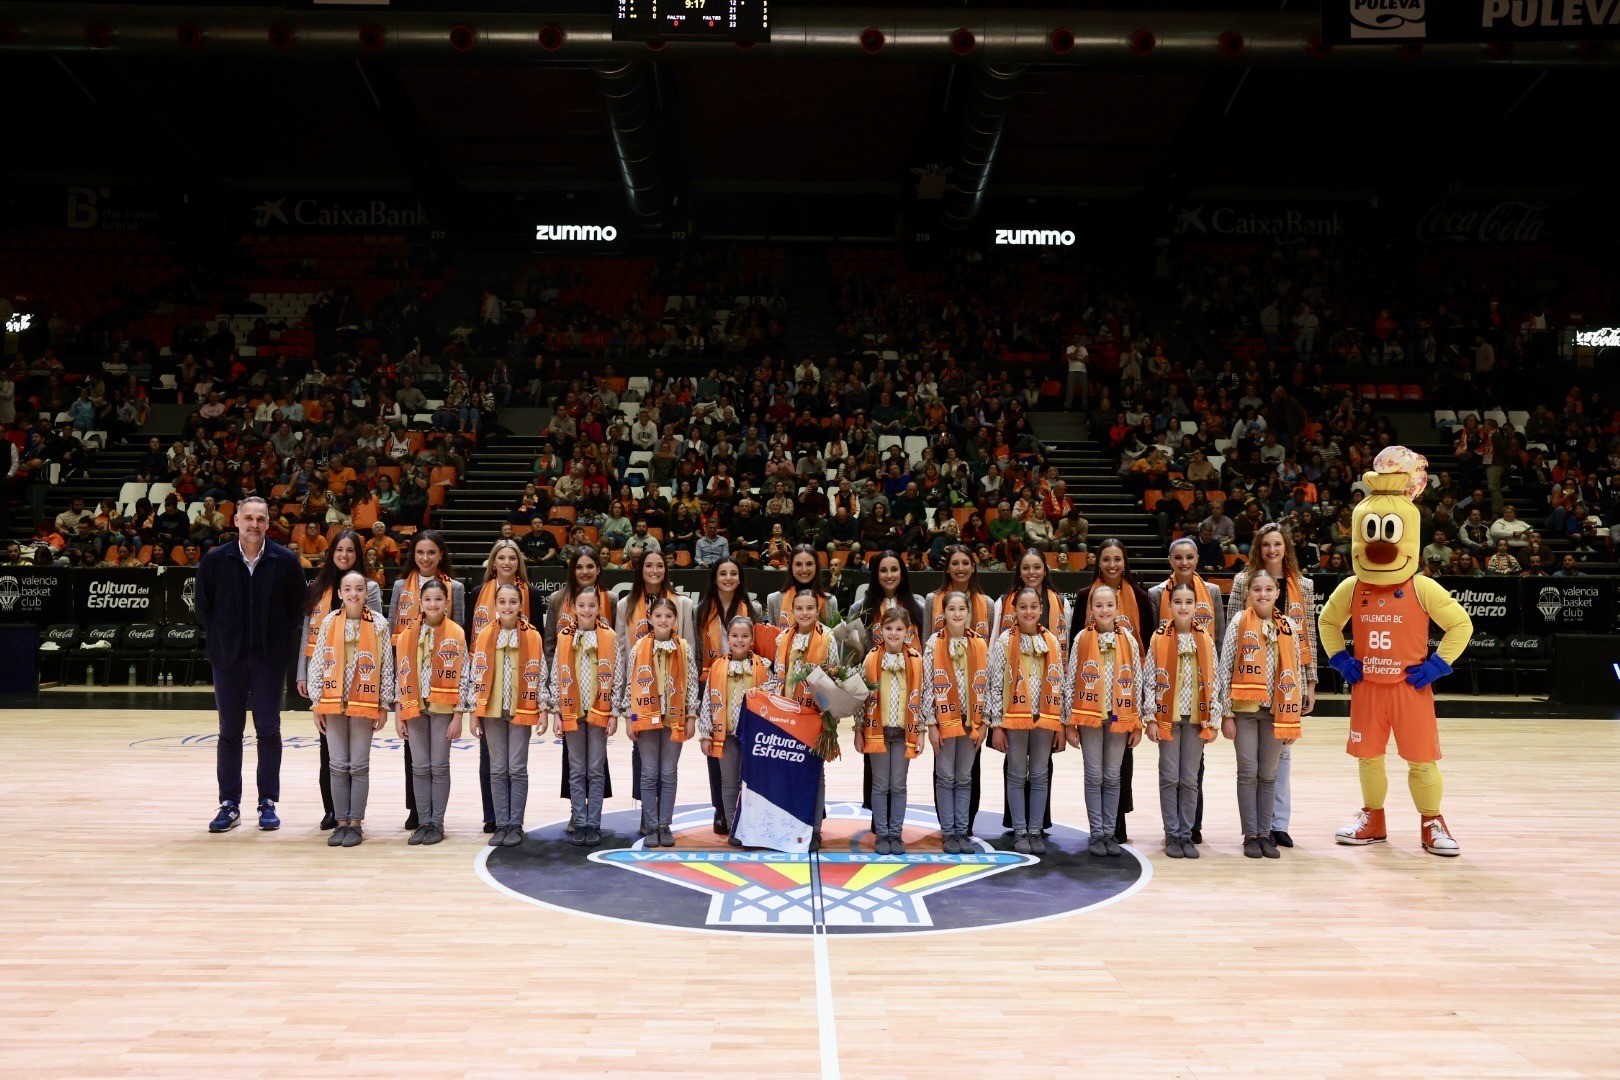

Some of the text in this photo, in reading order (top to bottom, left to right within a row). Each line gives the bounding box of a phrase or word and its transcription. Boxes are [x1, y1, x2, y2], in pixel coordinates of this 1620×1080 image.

[684, 0, 705, 8] 9:17
[1354, 0, 1421, 10] PULEVA
[294, 199, 430, 226] CaixaBank
[1212, 207, 1344, 236] CaixaBank
[536, 224, 617, 242] zummo
[995, 229, 1076, 246] zummo
[21, 576, 58, 586] valencia
[21, 586, 52, 597] basket
[88, 580, 150, 595] Cultura del
[1562, 586, 1599, 597] valencia
[20, 598, 42, 607] club
[87, 595, 150, 609] Esfuerzo
[1495, 595, 1506, 603] del
[1563, 597, 1592, 607] basket
[1562, 608, 1584, 618] club
[1360, 614, 1403, 624] VALENCIA BC
[1368, 630, 1392, 650] 86
[1362, 656, 1392, 666] Cultura
[437, 670, 457, 679] VBC
[1238, 664, 1262, 675] VBC
[1362, 665, 1402, 675] Esfuerzo
[636, 696, 656, 706] VBC
[1079, 692, 1099, 702] VBC
[1278, 703, 1298, 714] VBC
[754, 732, 806, 751] Cultura del
[752, 744, 805, 763] Esfuerzo
[630, 852, 1000, 863] VALENCIA BASKET
